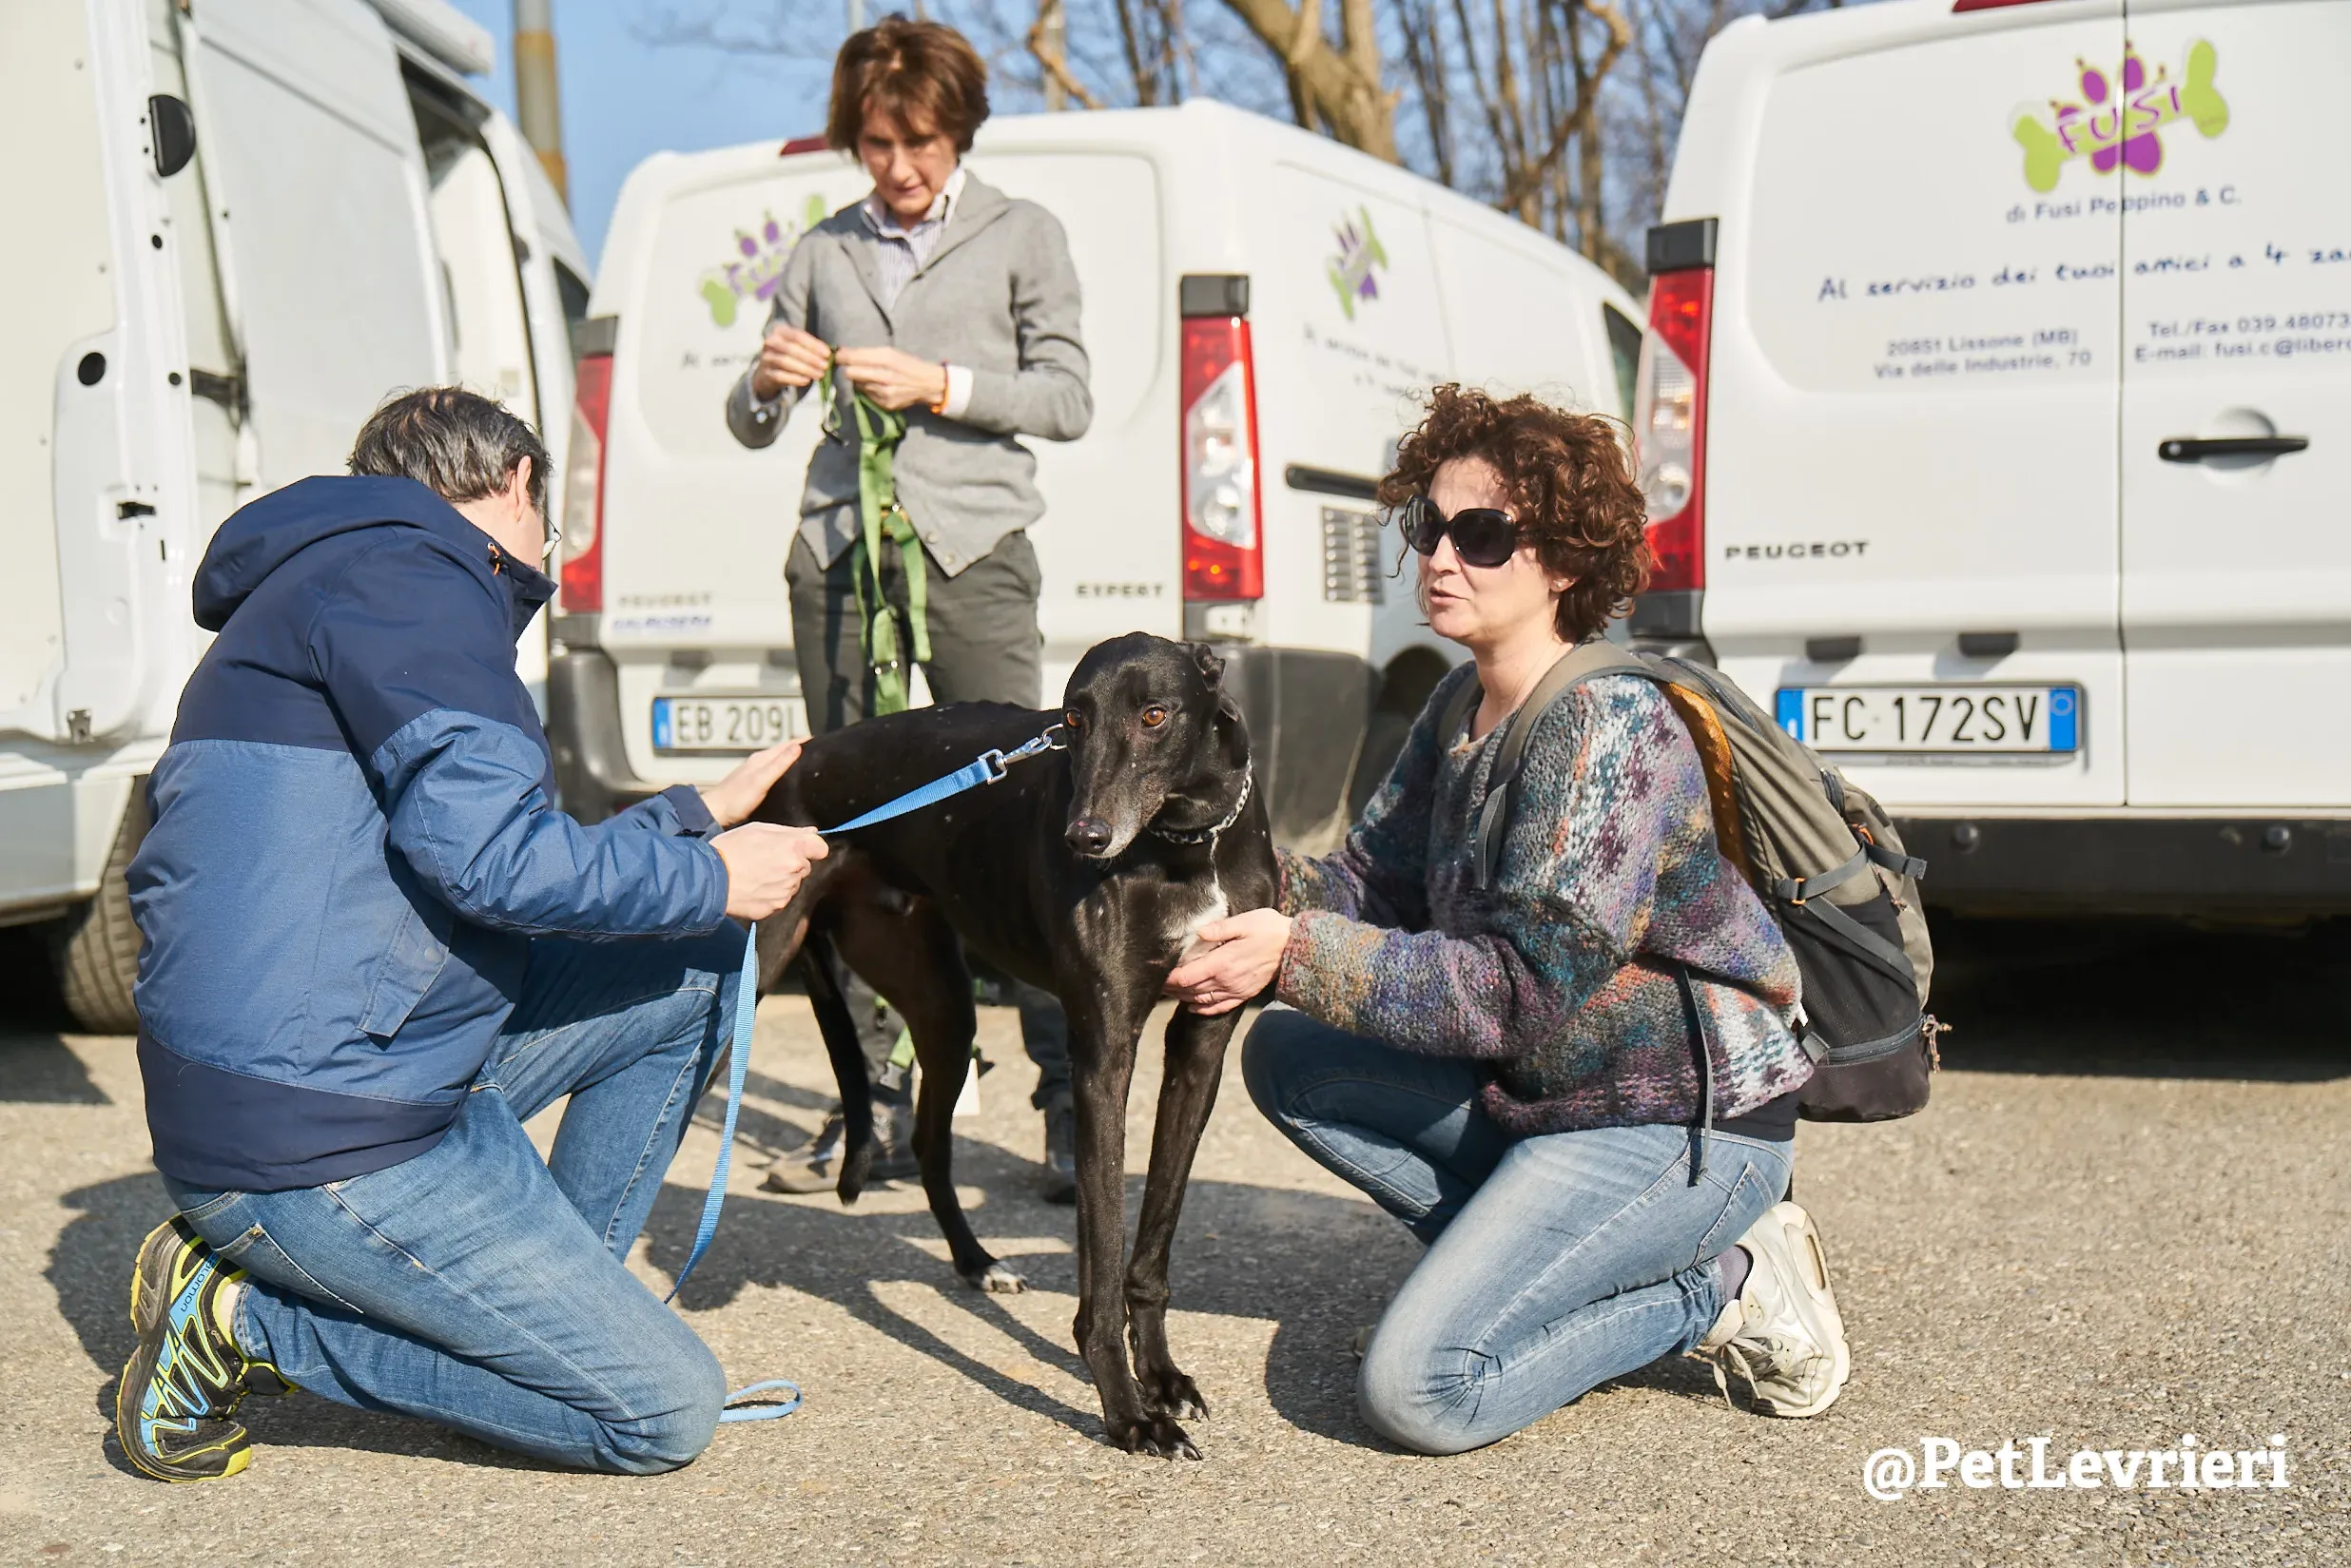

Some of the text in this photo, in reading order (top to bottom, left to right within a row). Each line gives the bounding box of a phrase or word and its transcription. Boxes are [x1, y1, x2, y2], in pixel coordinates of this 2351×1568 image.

[2057, 84, 2181, 153] FUSI
[2007, 186, 2242, 223] di Fusi Peppino & C.
[1817, 242, 2351, 302] Al servizio dei tuoi amici a 4 za
[1949, 335, 2025, 353] Lissone
[2032, 328, 2079, 347] (MB)
[1873, 362, 1904, 379] Via
[1911, 359, 1958, 377] delle
[2068, 349, 2092, 367] 70
[1725, 540, 1871, 559] PEUGEOT
[677, 706, 711, 743] EB
[1813, 696, 1865, 741] FC
[1894, 696, 2037, 741] 172SV
